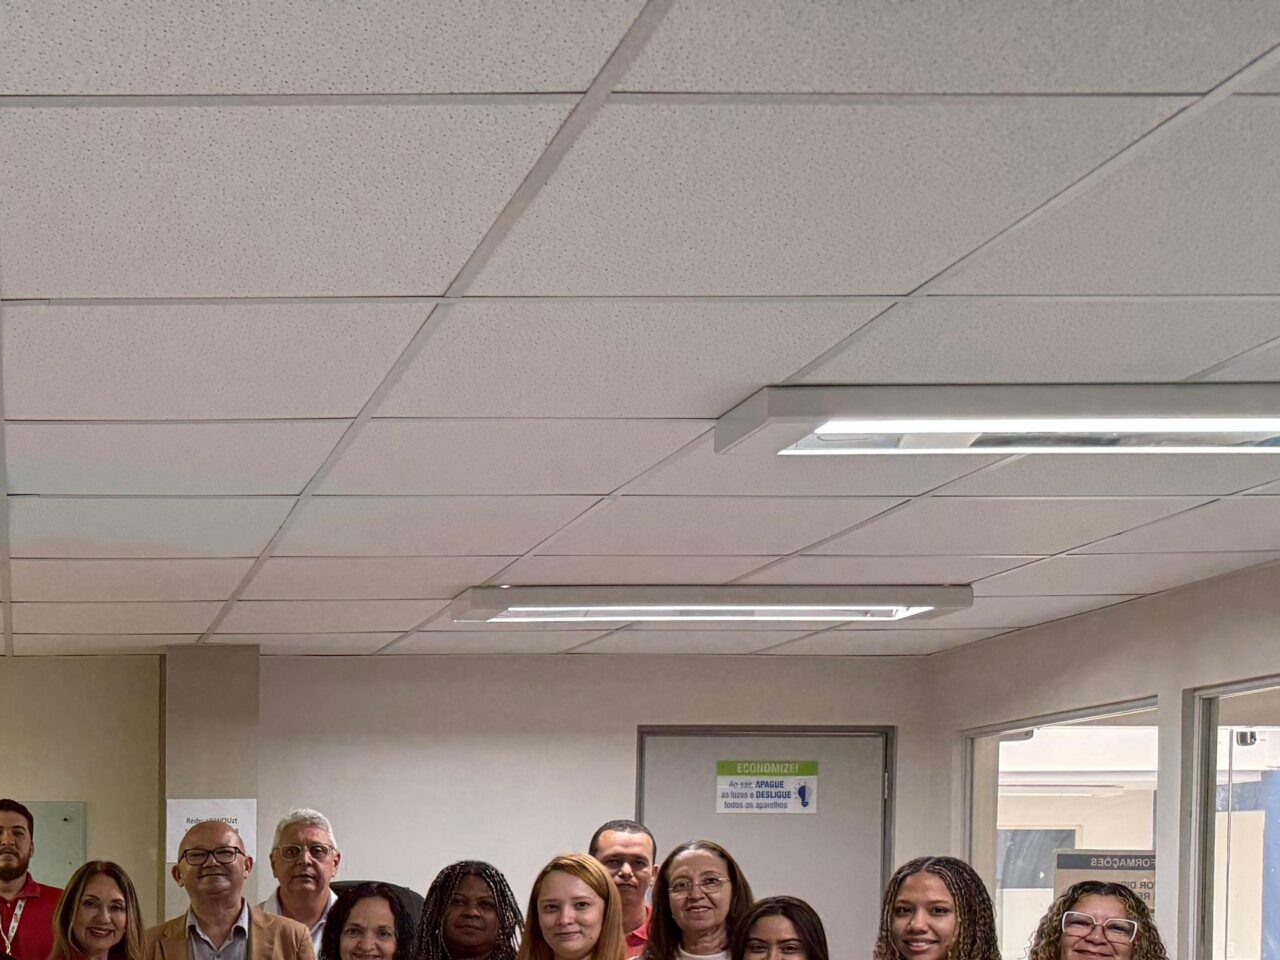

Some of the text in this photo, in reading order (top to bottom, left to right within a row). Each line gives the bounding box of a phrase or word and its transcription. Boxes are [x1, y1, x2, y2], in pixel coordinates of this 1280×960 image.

[737, 763, 799, 774] ECONOMIZE!
[755, 780, 784, 789] APAGUE
[731, 791, 748, 799] luzes
[756, 791, 792, 799] DESLIGUE
[755, 801, 788, 810] aparelhos
